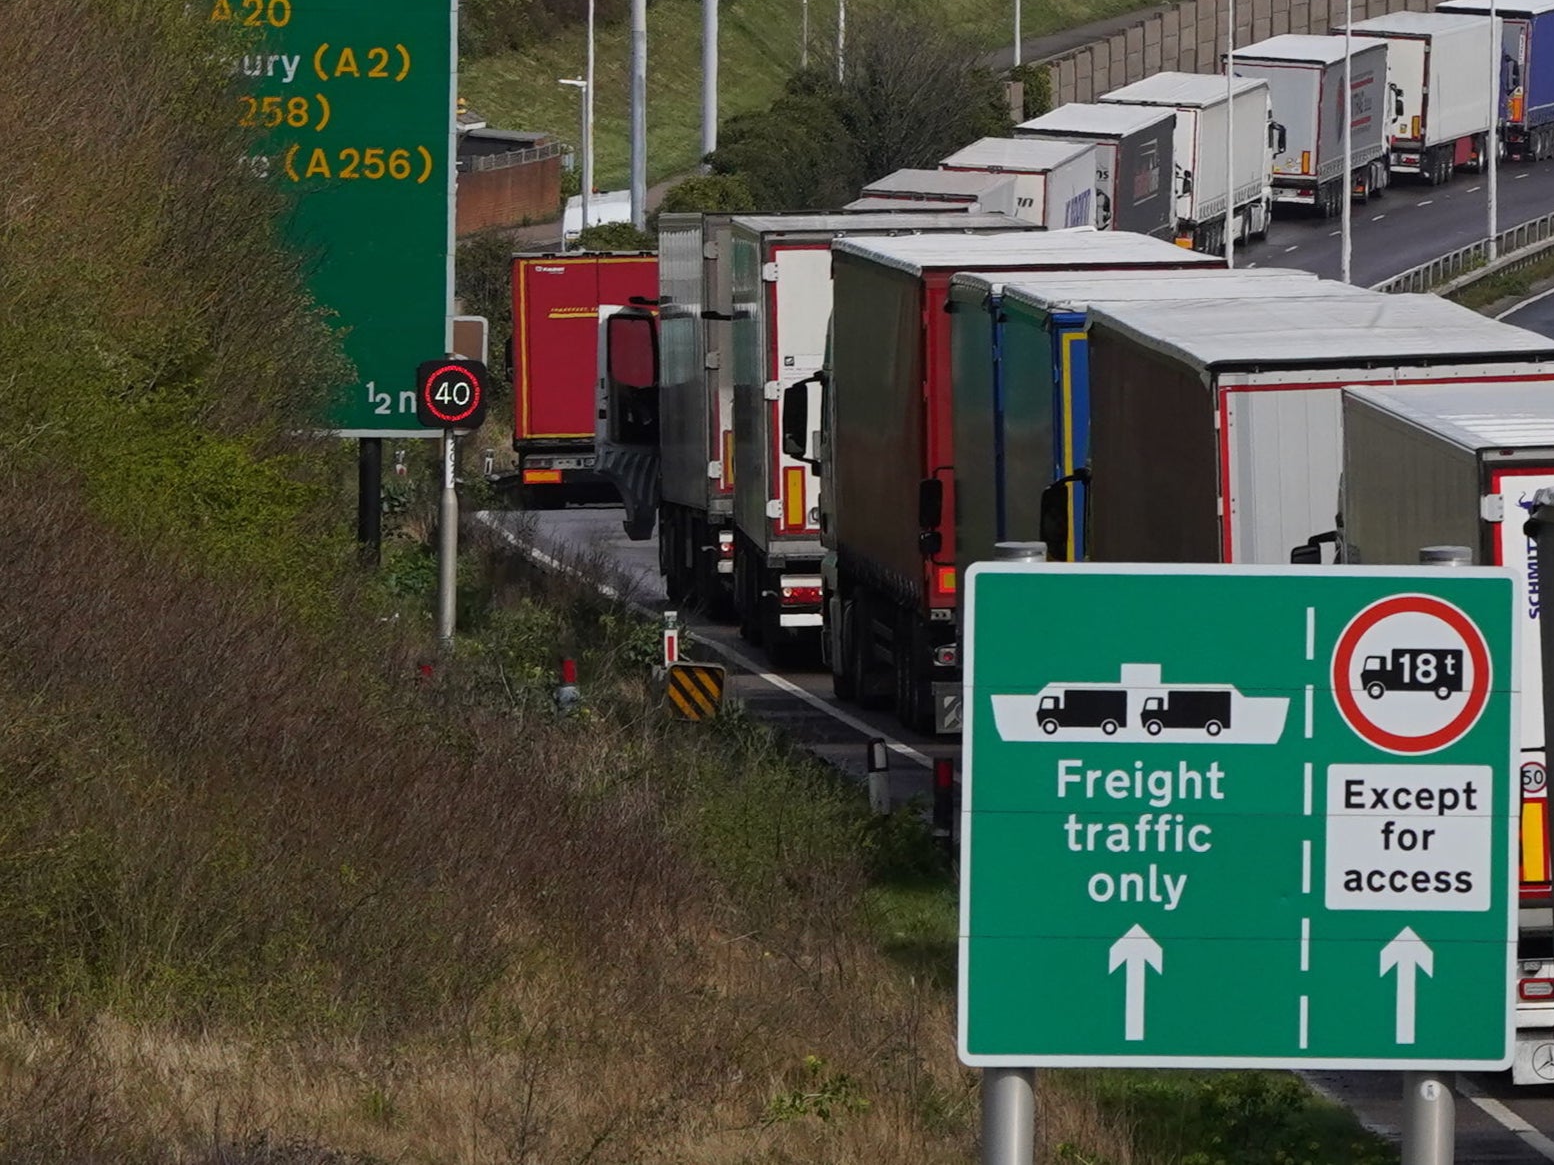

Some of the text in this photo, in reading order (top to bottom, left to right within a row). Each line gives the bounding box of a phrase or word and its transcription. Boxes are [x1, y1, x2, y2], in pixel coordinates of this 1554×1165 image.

[236, 43, 411, 84] ury (A2)
[238, 93, 331, 131] 258)
[285, 144, 433, 184] (A256)
[434, 381, 471, 406] 40
[1057, 759, 1225, 808] Freight
[1521, 770, 1544, 786] 50
[1344, 779, 1477, 817] Except
[1064, 813, 1212, 853] traffic
[1380, 820, 1436, 852] for
[1087, 863, 1188, 911] only
[1343, 869, 1473, 894] access
